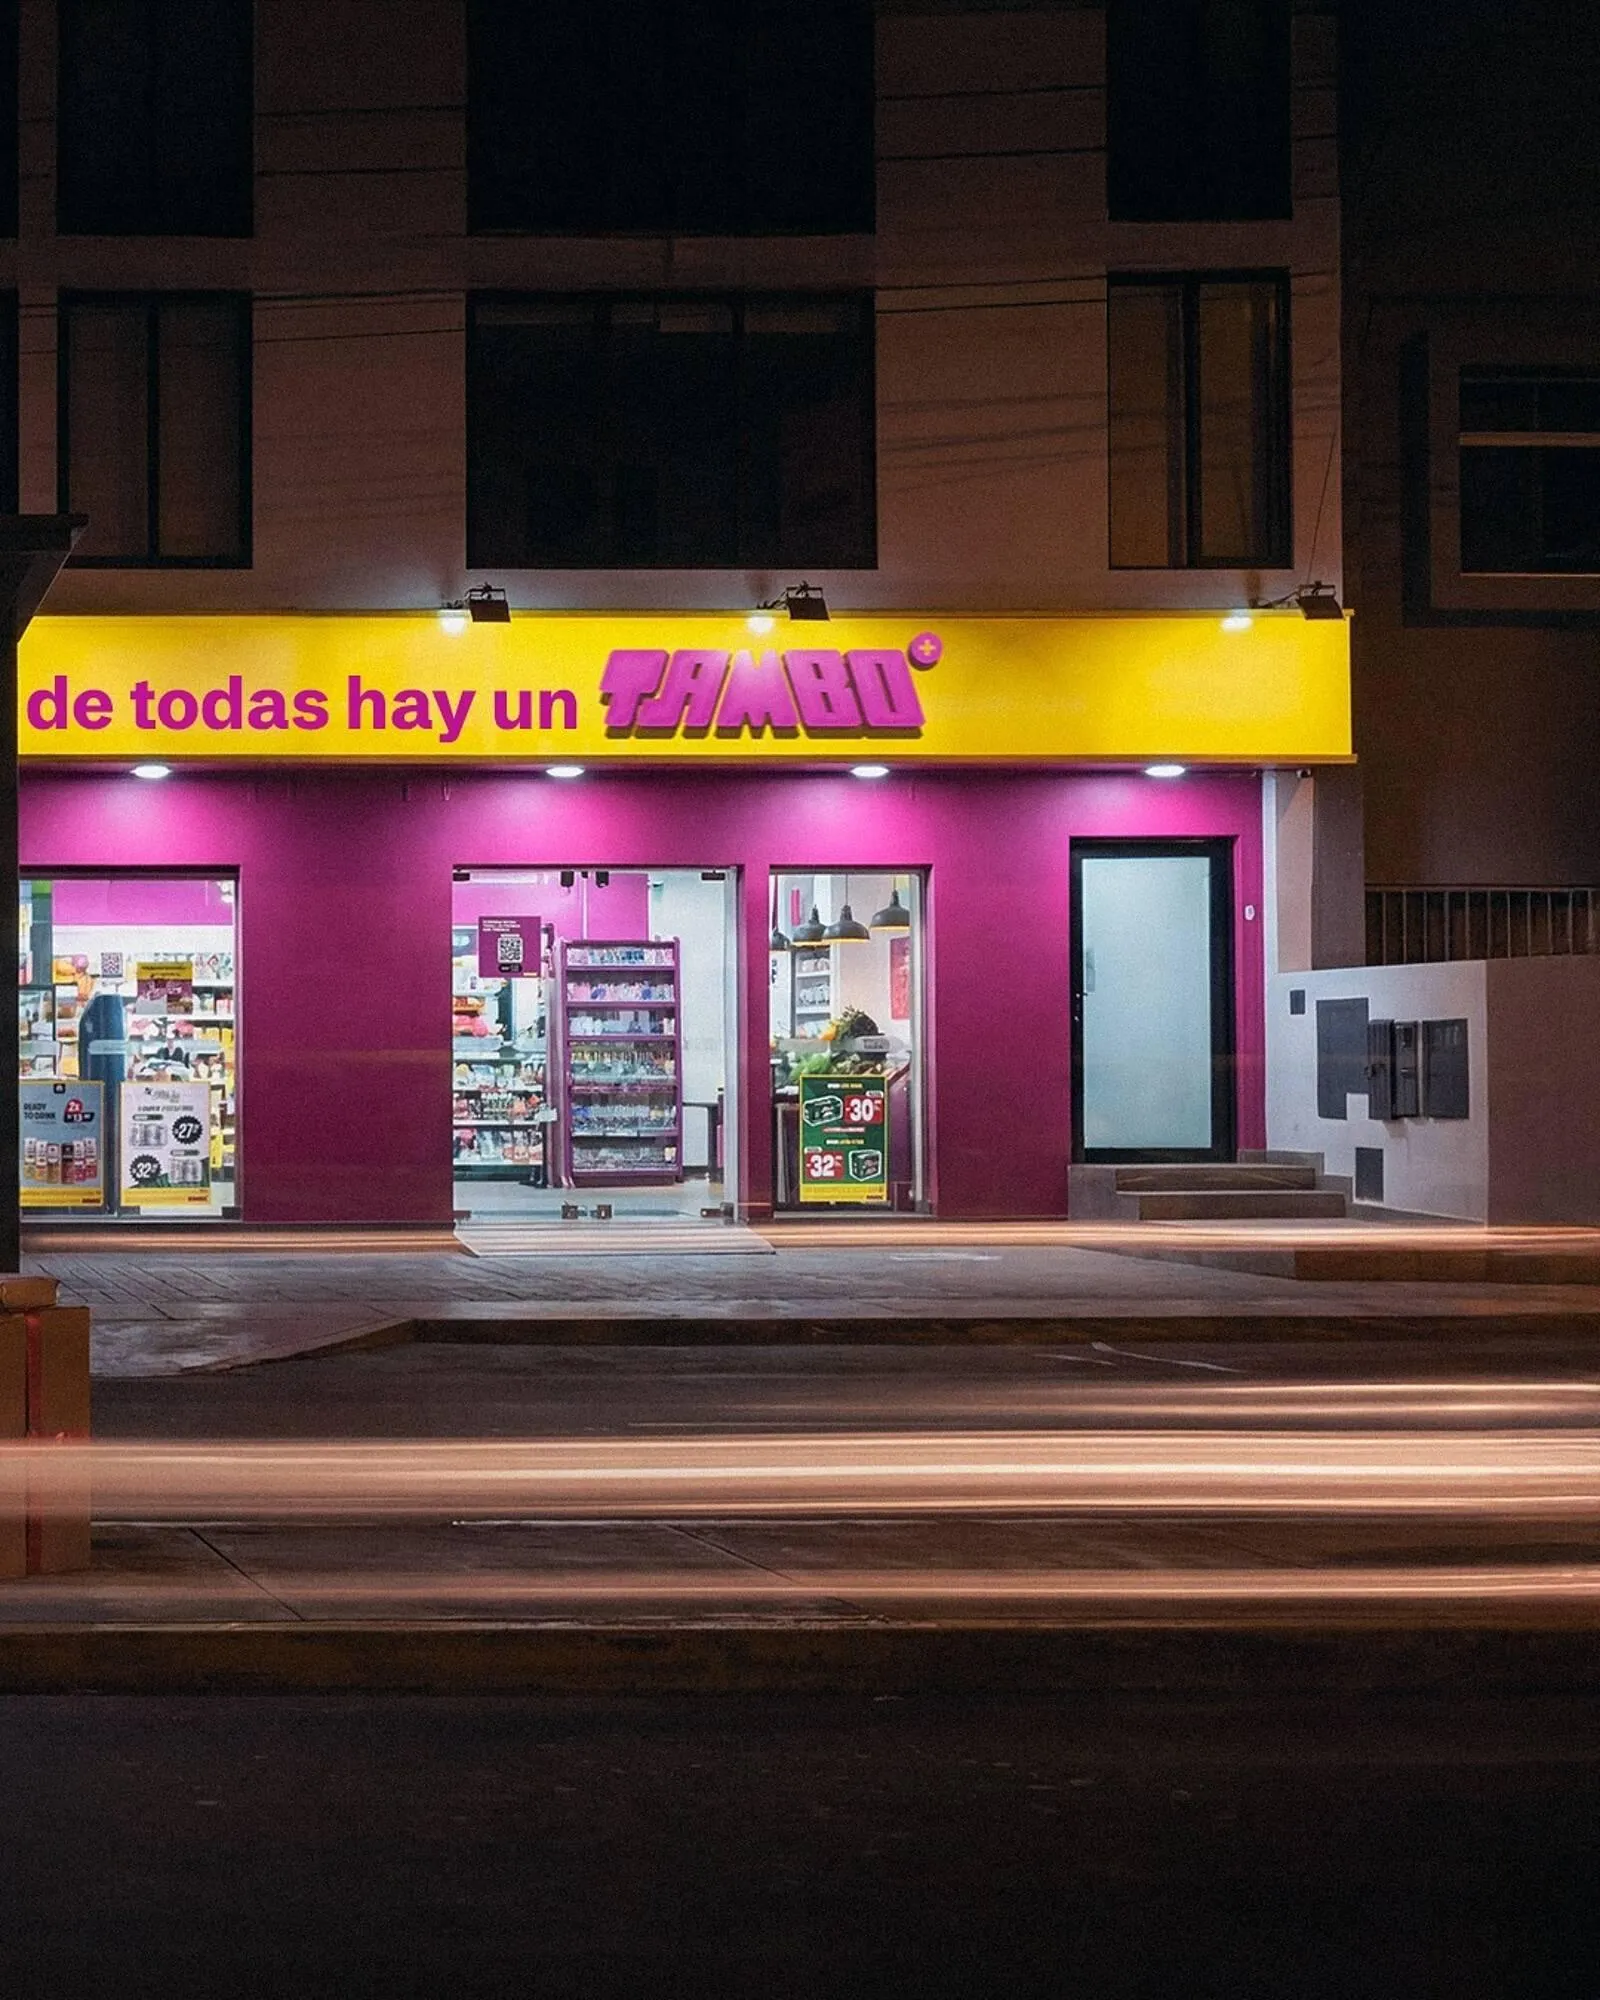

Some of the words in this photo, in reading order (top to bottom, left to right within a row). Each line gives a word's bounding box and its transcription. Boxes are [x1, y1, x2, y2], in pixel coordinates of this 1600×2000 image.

[26, 675, 114, 731] de
[130, 675, 330, 731] todas
[348, 675, 475, 743] hay
[494, 686, 578, 731] un
